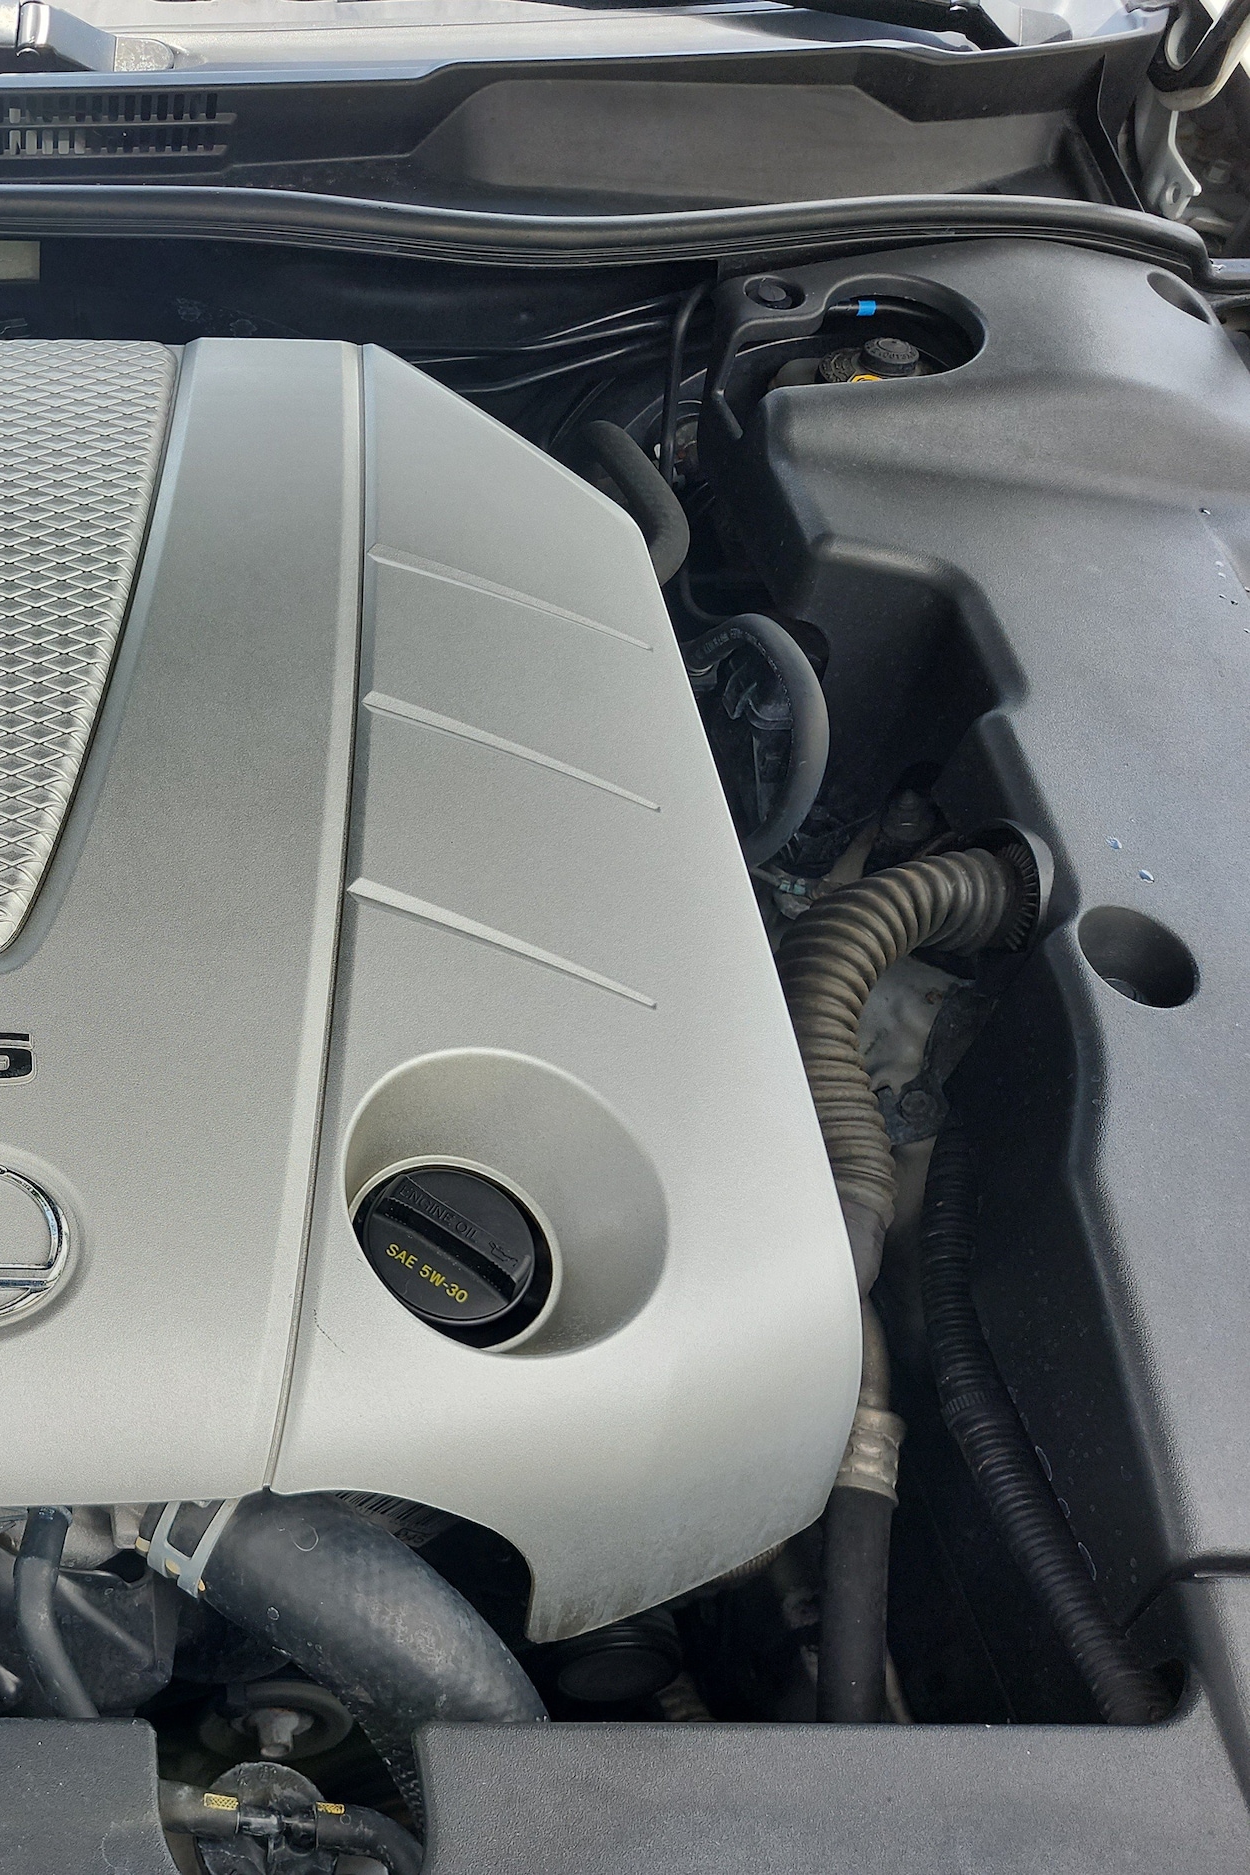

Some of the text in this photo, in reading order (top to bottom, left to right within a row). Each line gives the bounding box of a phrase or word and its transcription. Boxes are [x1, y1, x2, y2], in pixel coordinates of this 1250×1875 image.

[399, 1185, 478, 1243] ENGINE OIL
[386, 1243, 468, 1303] SAE 5W-30
